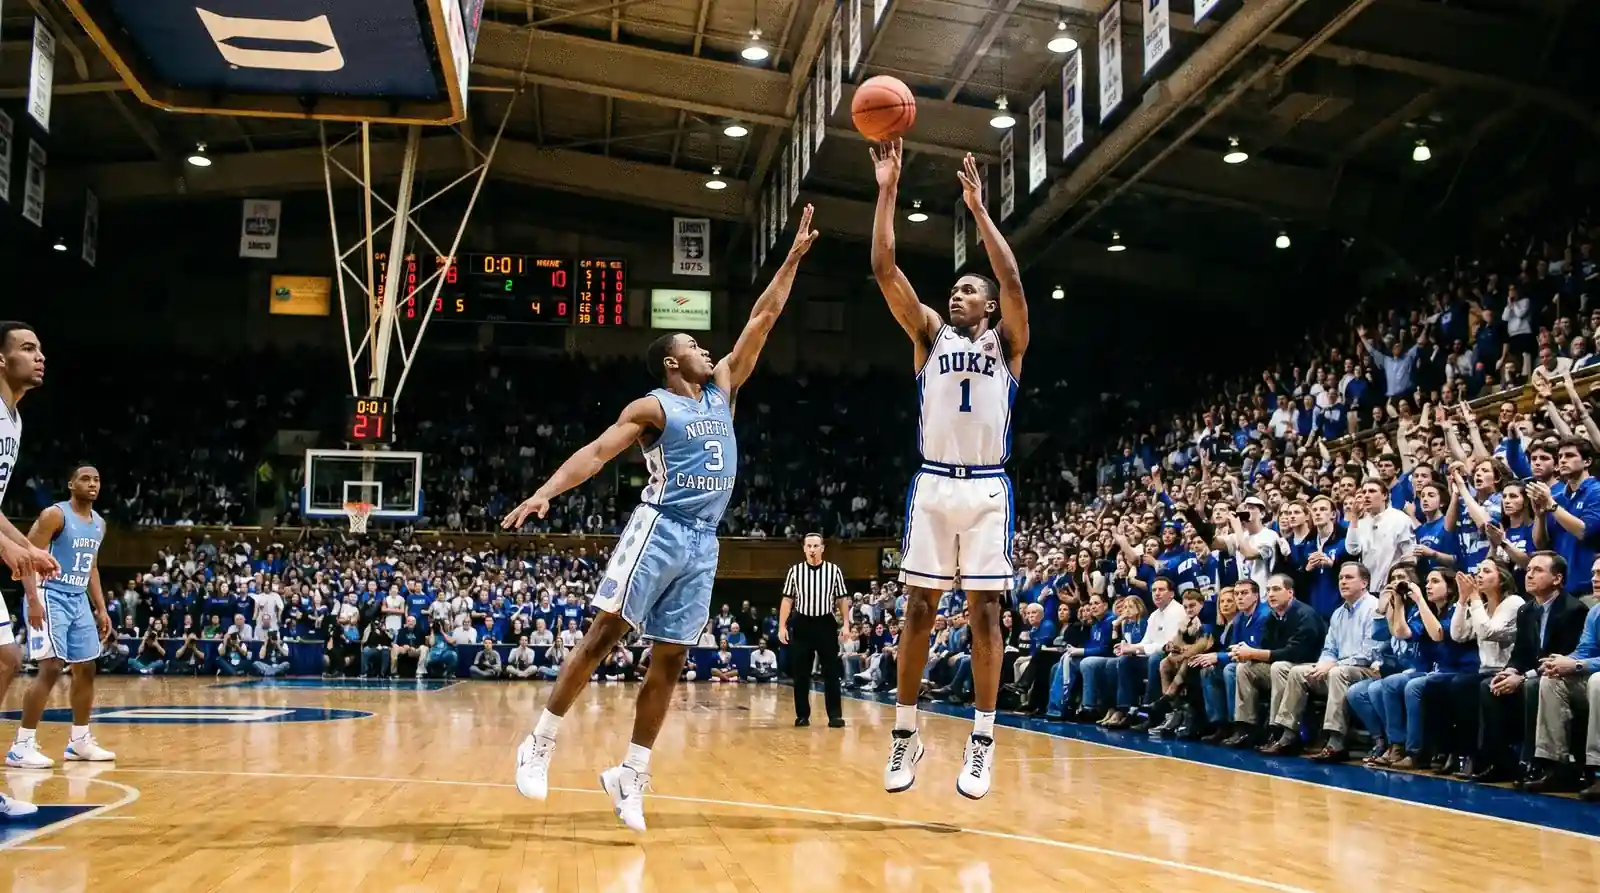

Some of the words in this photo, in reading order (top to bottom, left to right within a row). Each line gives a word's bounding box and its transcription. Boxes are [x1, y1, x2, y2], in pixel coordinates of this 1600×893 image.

[484, 256, 523, 273] 0:01
[504, 280, 513, 291] 2
[552, 270, 567, 288] 10
[532, 302, 540, 314] 4
[938, 351, 997, 378] DUKE
[959, 378, 972, 413] 1
[357, 400, 388, 414] 0:01
[353, 414, 383, 438] 21
[685, 419, 729, 440] NORTH
[703, 439, 725, 472] 3
[72, 551, 94, 573] 13
